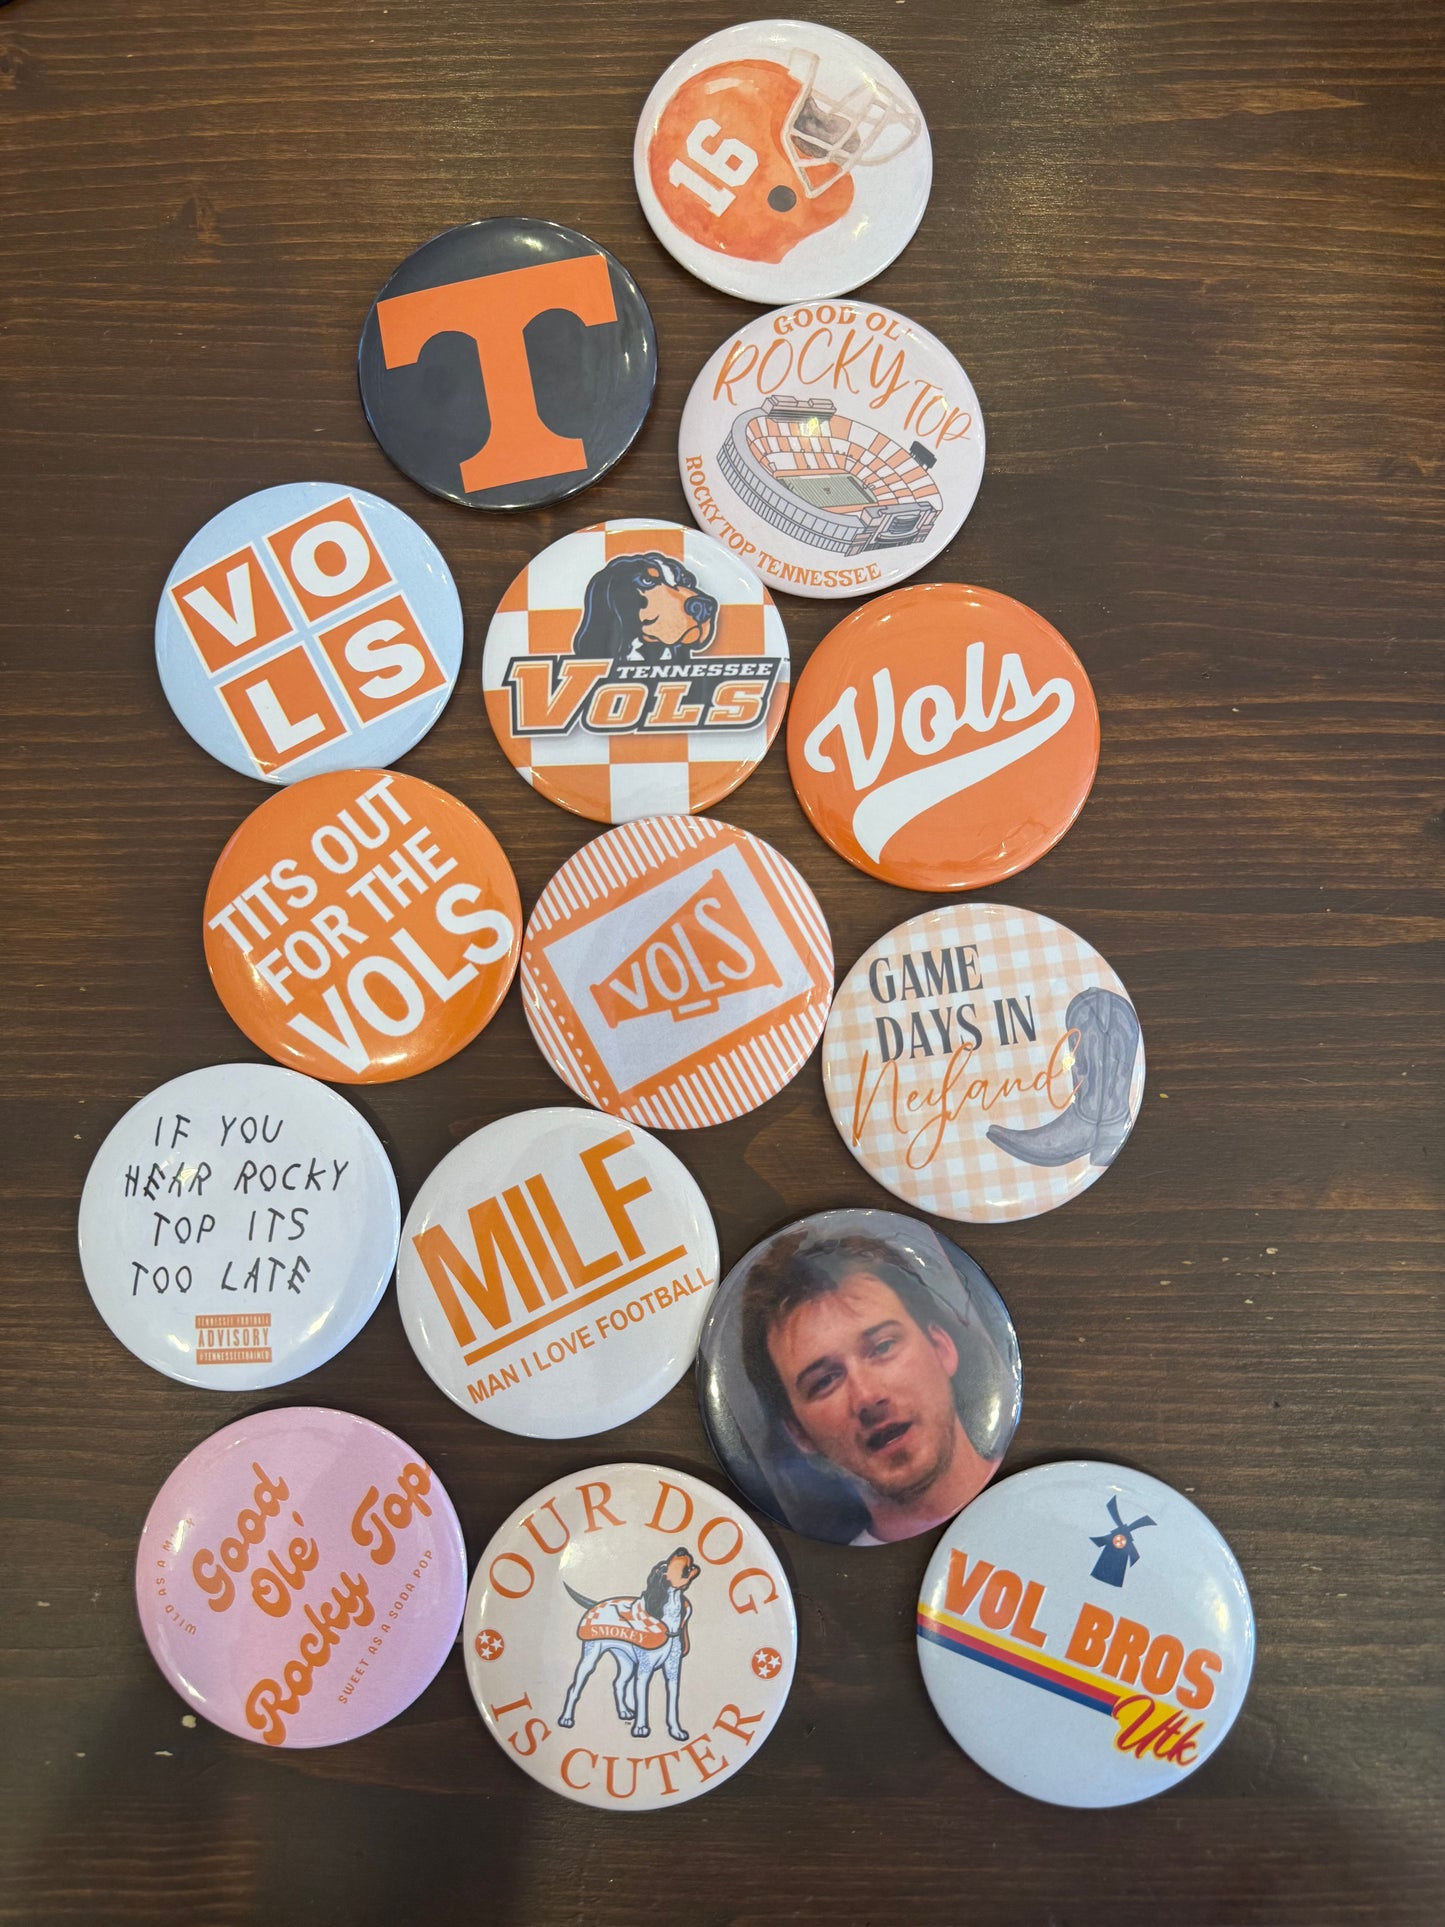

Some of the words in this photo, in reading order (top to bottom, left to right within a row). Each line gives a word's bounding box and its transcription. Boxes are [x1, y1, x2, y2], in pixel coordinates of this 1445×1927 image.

[668, 118, 759, 217] 16
[376, 254, 618, 494] T
[773, 305, 856, 335] GOOD
[712, 328, 910, 410] ROCKY
[903, 379, 972, 449] TOP
[685, 455, 724, 524] ROCKY
[718, 520, 757, 556] TOP
[756, 551, 882, 588] TENNESSEE
[616, 663, 774, 680] TENNESSEE
[804, 641, 1075, 791] Vols
[208, 859, 318, 955] TITS
[311, 776, 412, 874] OUT
[255, 905, 369, 1005] FOR
[346, 826, 458, 922] THE
[287, 883, 515, 1075] VOLS
[609, 897, 756, 1010] VOLS
[868, 944, 984, 1004] GAME
[875, 1003, 983, 1063] DAYS
[992, 995, 1037, 1045] IN
[154, 1114, 191, 1148] IF
[221, 1115, 283, 1146] YOU
[852, 1028, 1084, 1170] Neyland
[125, 1162, 212, 1201] HEAR
[234, 1158, 349, 1194] ROCKY
[153, 1212, 216, 1246] TOP
[248, 1208, 309, 1242] ITS
[412, 1130, 653, 1348] MILF
[131, 1261, 192, 1296] TOO
[221, 1256, 311, 1294] LATE
[466, 1364, 520, 1404] MAN
[520, 1357, 533, 1378] I
[532, 1326, 596, 1371] LOVE
[595, 1267, 715, 1339] FOOTBALL
[198, 1327, 269, 1347] ADVISORY
[192, 1462, 290, 1613] Good
[489, 1481, 627, 1599] OUR
[644, 1480, 779, 1616] DOG
[165, 1604, 197, 1635] WILD
[245, 1571, 375, 1746] Rocky
[351, 1461, 432, 1565] Top
[338, 1658, 370, 1704] SWEET
[368, 1636, 383, 1655] AS
[381, 1624, 391, 1633] A
[389, 1583, 415, 1620] SODA
[413, 1550, 433, 1578] POP
[591, 1625, 649, 1644] SMOKEY
[943, 1547, 1048, 1649] VOL
[1064, 1602, 1223, 1710] BROS
[490, 1692, 552, 1756] IS
[560, 1702, 766, 1799] CUTER
